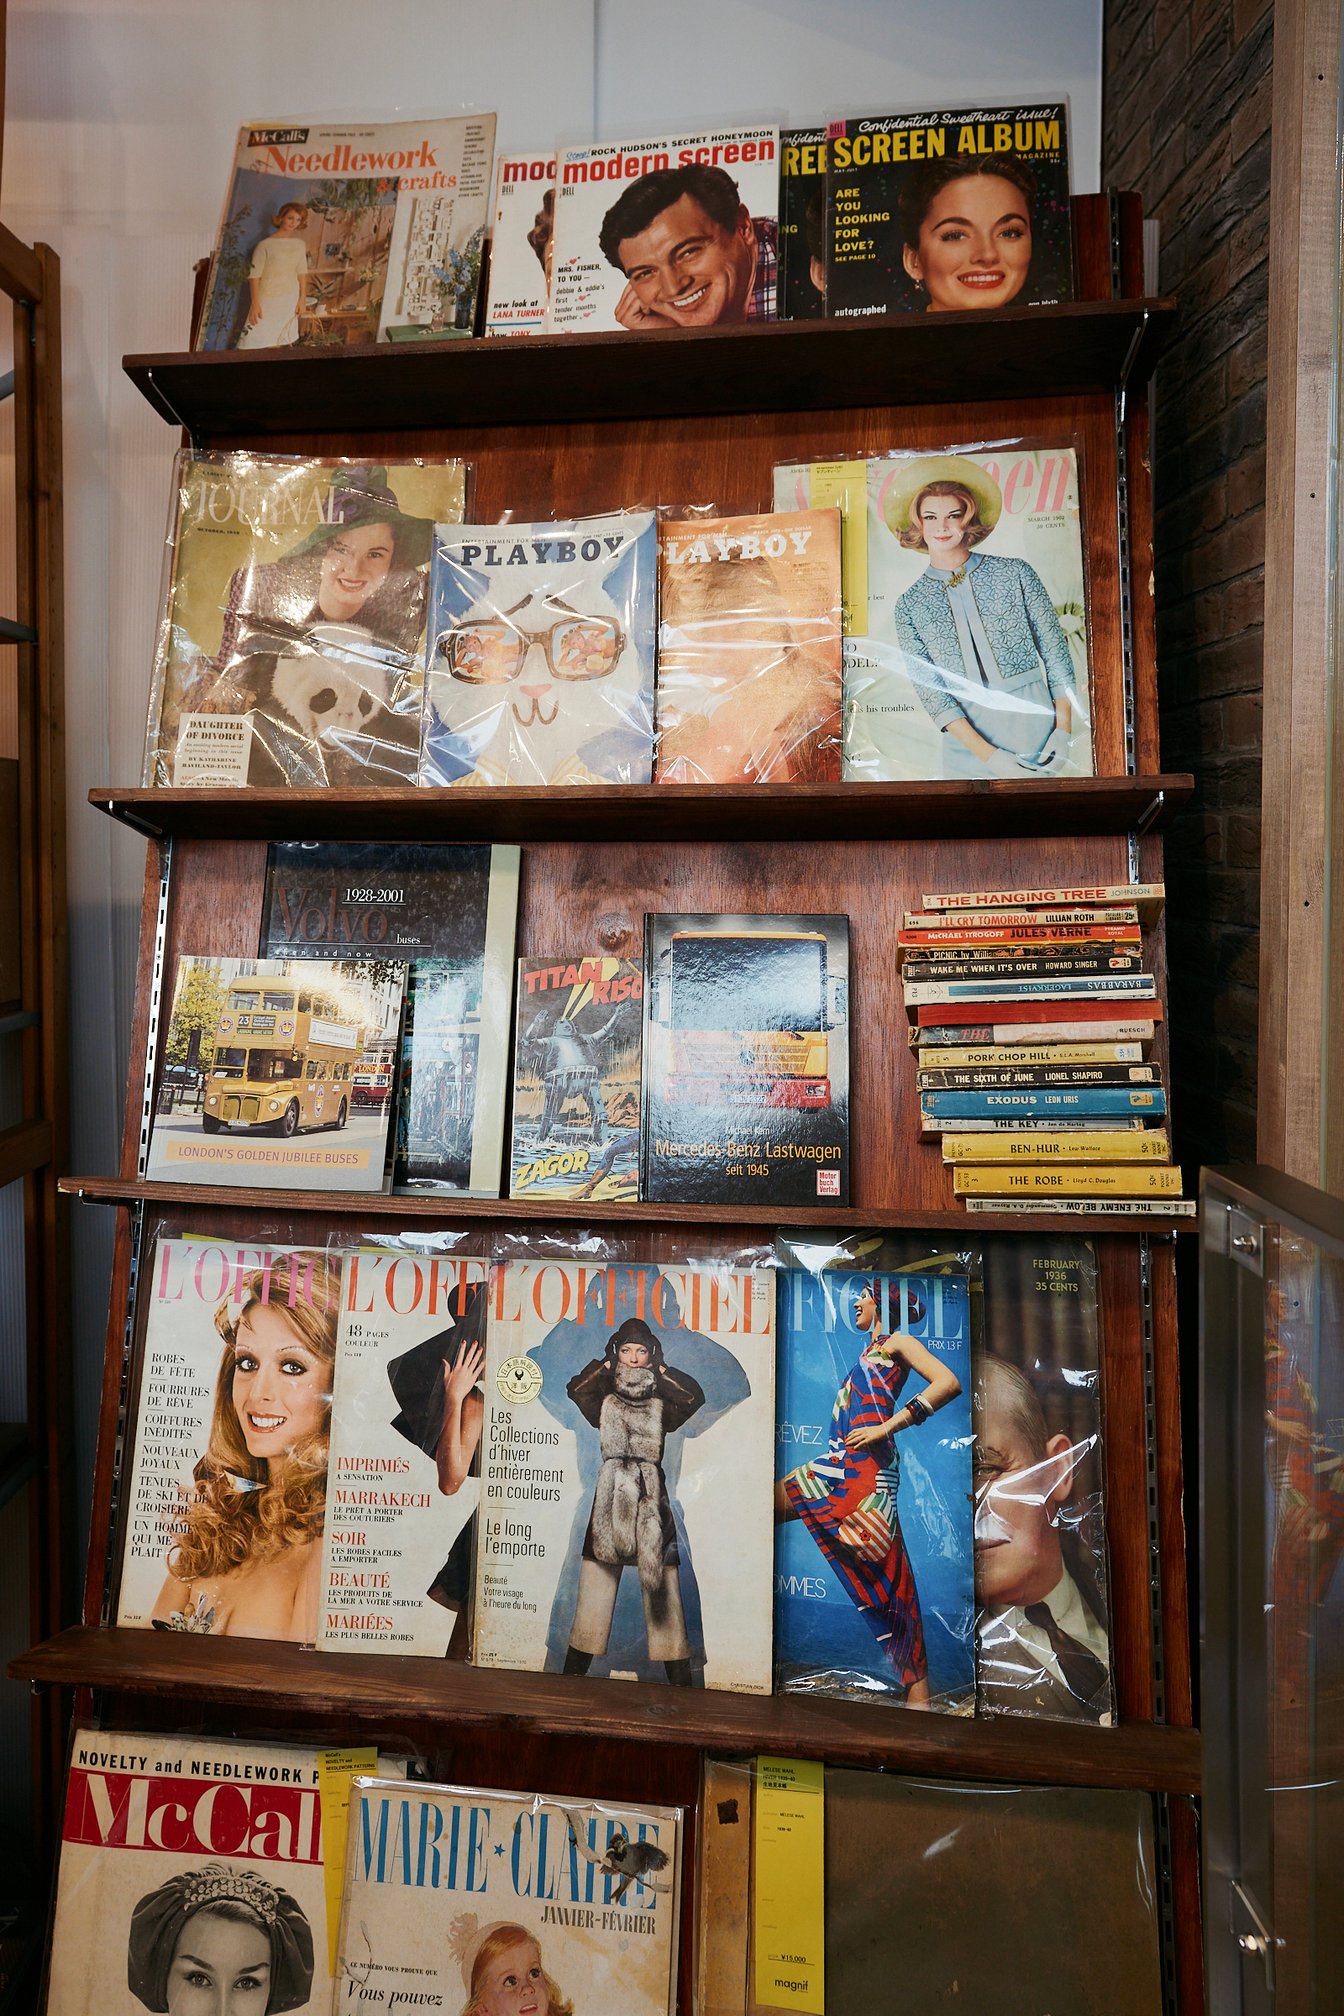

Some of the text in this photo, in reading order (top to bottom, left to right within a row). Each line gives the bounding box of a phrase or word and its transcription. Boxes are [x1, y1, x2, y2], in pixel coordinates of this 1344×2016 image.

[859, 107, 1059, 133] Confidential Sweetheart issue!
[251, 128, 307, 145] McCall's
[591, 147, 617, 157] ROCK
[620, 140, 668, 153] HUDSON'S
[672, 135, 707, 147] SECRET
[710, 129, 773, 143] HONEYMOON
[834, 120, 1060, 168] SCREEN ALBUM
[265, 141, 439, 176] Needlework
[563, 139, 775, 184] modern screen
[1015, 151, 1060, 160] MAGAZINE
[376, 170, 457, 193] & crafts
[836, 188, 860, 199] ARE
[836, 201, 861, 213] YOU
[835, 211, 890, 226] LOOKING
[835, 228, 859, 239] FOR
[834, 240, 874, 253] LOVE?
[849, 254, 866, 262] PAGE
[558, 264, 602, 274] MRS. FISHER,
[556, 286, 574, 295] debbie
[585, 284, 605, 292] eddie's
[576, 303, 597, 312] months
[834, 304, 887, 317] autographed
[460, 535, 624, 566] PLAYBOY
[190, 720, 244, 730] DAUGHTER
[186, 731, 245, 741] OF DIVORCE
[345, 888, 405, 903] 1928-2001
[937, 888, 1150, 907] THE HANGING TREE JOHNSON
[274, 887, 389, 942] Volvo
[940, 914, 1095, 927] I'LL CRY TOMORROW LILLIAN ROTH
[396, 933, 421, 945] buses
[965, 930, 1005, 939] STROGOFF
[1009, 928, 1047, 939] JULES
[1051, 927, 1092, 937] VERNE
[929, 965, 954, 974] WAKE
[955, 965, 969, 973] ME
[971, 964, 995, 973] WHEN
[997, 963, 1013, 972] IT'S
[1016, 963, 1038, 971] OVER
[1045, 961, 1072, 970] HOWARD
[1074, 960, 1098, 969] SINGER
[524, 961, 603, 995] TITAN
[1018, 980, 1141, 992] BARABBAS LAGERKVIST
[239, 1015, 250, 1025] 23
[960, 1028, 990, 1040] THE
[968, 1053, 995, 1062] PORK
[998, 1053, 1026, 1061] CHOP
[1029, 1052, 1051, 1060] HILL
[358, 1064, 385, 1074] LONDON
[954, 1071, 1103, 1083] THE SIXTH OF JUNE LIONEL SHAPIRO
[986, 1095, 1079, 1105] EXODUS LEON URIS
[178, 1146, 359, 1165] LONDON'S GOLDEN JUBILEE BUSES
[655, 1139, 842, 1163] Mercedes-Benz Lastwagen
[1010, 1144, 1060, 1153] BEN-HUR
[515, 1150, 590, 1191] ZAGOR
[725, 1163, 769, 1176] seit 1945
[819, 1172, 837, 1180] Motor
[1008, 1175, 1029, 1185] THE
[1035, 1175, 1063, 1185] ROBE
[819, 1186, 838, 1194] Verlag
[1033, 1258, 1080, 1271] FEBRUARY
[1045, 1271, 1067, 1281] 1936
[496, 1265, 771, 1335] L'OFFICIEL
[152, 1353, 185, 1365] ROBES
[148, 1383, 210, 1397] FOURRURES
[145, 1414, 203, 1427] COIFFURES
[491, 1407, 512, 1424] Les
[143, 1425, 192, 1439] INÉDITES
[489, 1426, 560, 1446] Collections
[142, 1445, 200, 1459] NOUVEAUX
[488, 1445, 531, 1462] d'hiver
[140, 1456, 181, 1470] JOYAUX
[337, 1456, 410, 1474] IMPRIMÉS
[488, 1463, 564, 1483] entièrement
[139, 1476, 180, 1488] TENUES
[335, 1490, 431, 1508] MARRAKECH
[487, 1484, 561, 1502] en couleurs
[135, 1501, 192, 1515] CROISIÈRE
[486, 1518, 532, 1541] Le long
[331, 1531, 367, 1546] SOIR
[485, 1537, 546, 1559] l'emporte
[329, 1571, 390, 1589] BEAUTÉ
[484, 1574, 508, 1586] Beauté
[326, 1613, 393, 1631] MARIÉES
[79, 1750, 302, 1783] NOVELTY and NEEDLEWORK
[353, 1797, 660, 1910] MARIE CLAIRE
[540, 1903, 657, 1935] JANVIER-FÉVRIER
[781, 1953, 807, 1964] ¥15,000
[360, 1961, 383, 1971] NUMÉRO
[400, 1967, 424, 1975] PROUVE
[774, 1979, 809, 1992] magnif
[348, 1979, 443, 2009] Vous pouvez
